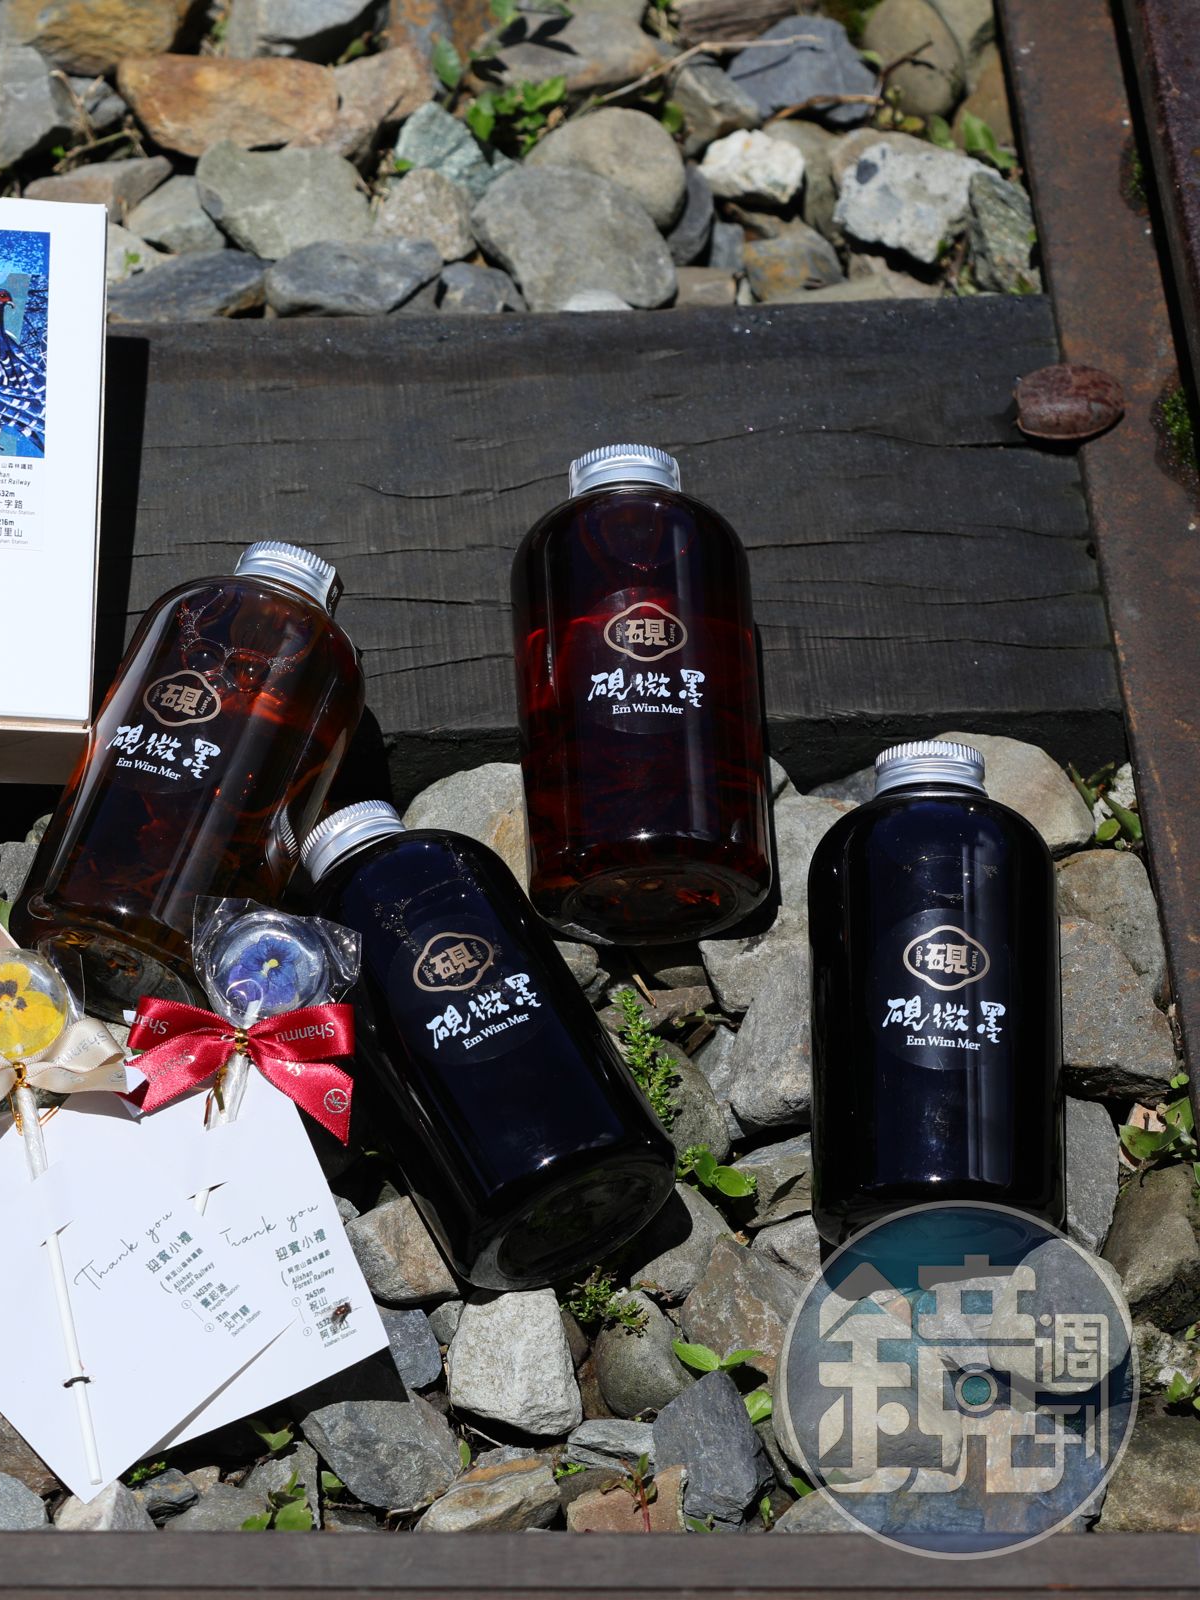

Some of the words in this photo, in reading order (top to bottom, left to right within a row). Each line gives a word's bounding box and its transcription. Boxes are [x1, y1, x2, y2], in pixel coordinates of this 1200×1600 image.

[8, 479, 31, 487] Railway
[612, 705, 631, 715] Em
[661, 704, 684, 715] Mer
[116, 757, 132, 769] Em
[158, 766, 181, 780] Mer
[462, 1035, 484, 1049] Em
[507, 1013, 530, 1027] Mer
[906, 1035, 926, 1046] Em
[957, 1038, 981, 1050] Mer
[286, 1204, 319, 1233] you
[73, 1238, 139, 1290] Thank
[145, 1210, 173, 1244] you
[145, 1230, 193, 1274] 迎賓小禮
[275, 1228, 326, 1261] 迎賓小禮
[173, 1272, 193, 1290] Alishan
[177, 1279, 195, 1295] Forest
[194, 1262, 215, 1281] Railway
[292, 1271, 313, 1284] Alishan
[294, 1279, 313, 1291] Forest
[314, 1267, 335, 1281] Railway
[193, 1282, 213, 1299] 1403m
[305, 1287, 326, 1300] 2451m
[309, 1297, 328, 1311] 祝山
[216, 1311, 229, 1322] 31m
[316, 1316, 335, 1330] 1532
